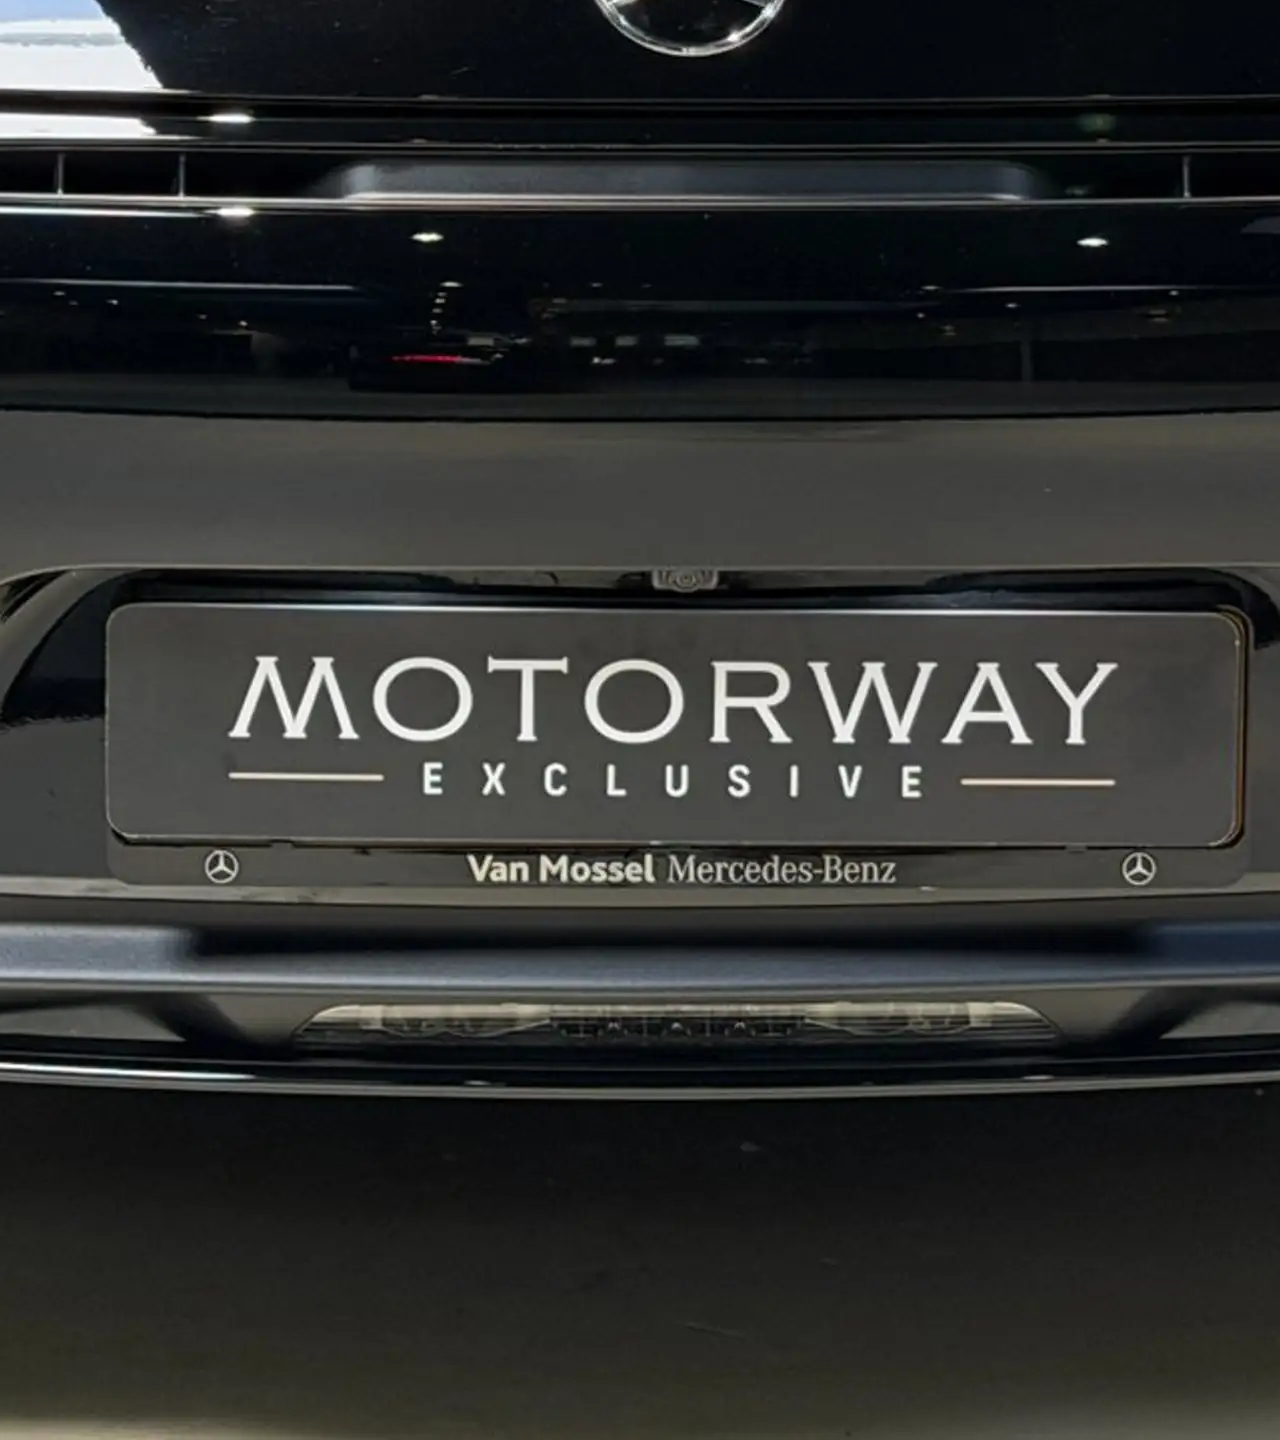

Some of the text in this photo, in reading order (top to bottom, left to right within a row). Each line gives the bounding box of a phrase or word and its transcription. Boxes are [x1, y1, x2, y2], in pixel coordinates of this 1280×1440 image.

[227, 654, 1119, 746] MOTORWAY
[422, 760, 923, 800] EXCLUSIVE
[466, 852, 897, 885] Van Mossel Mercedes-Benz
